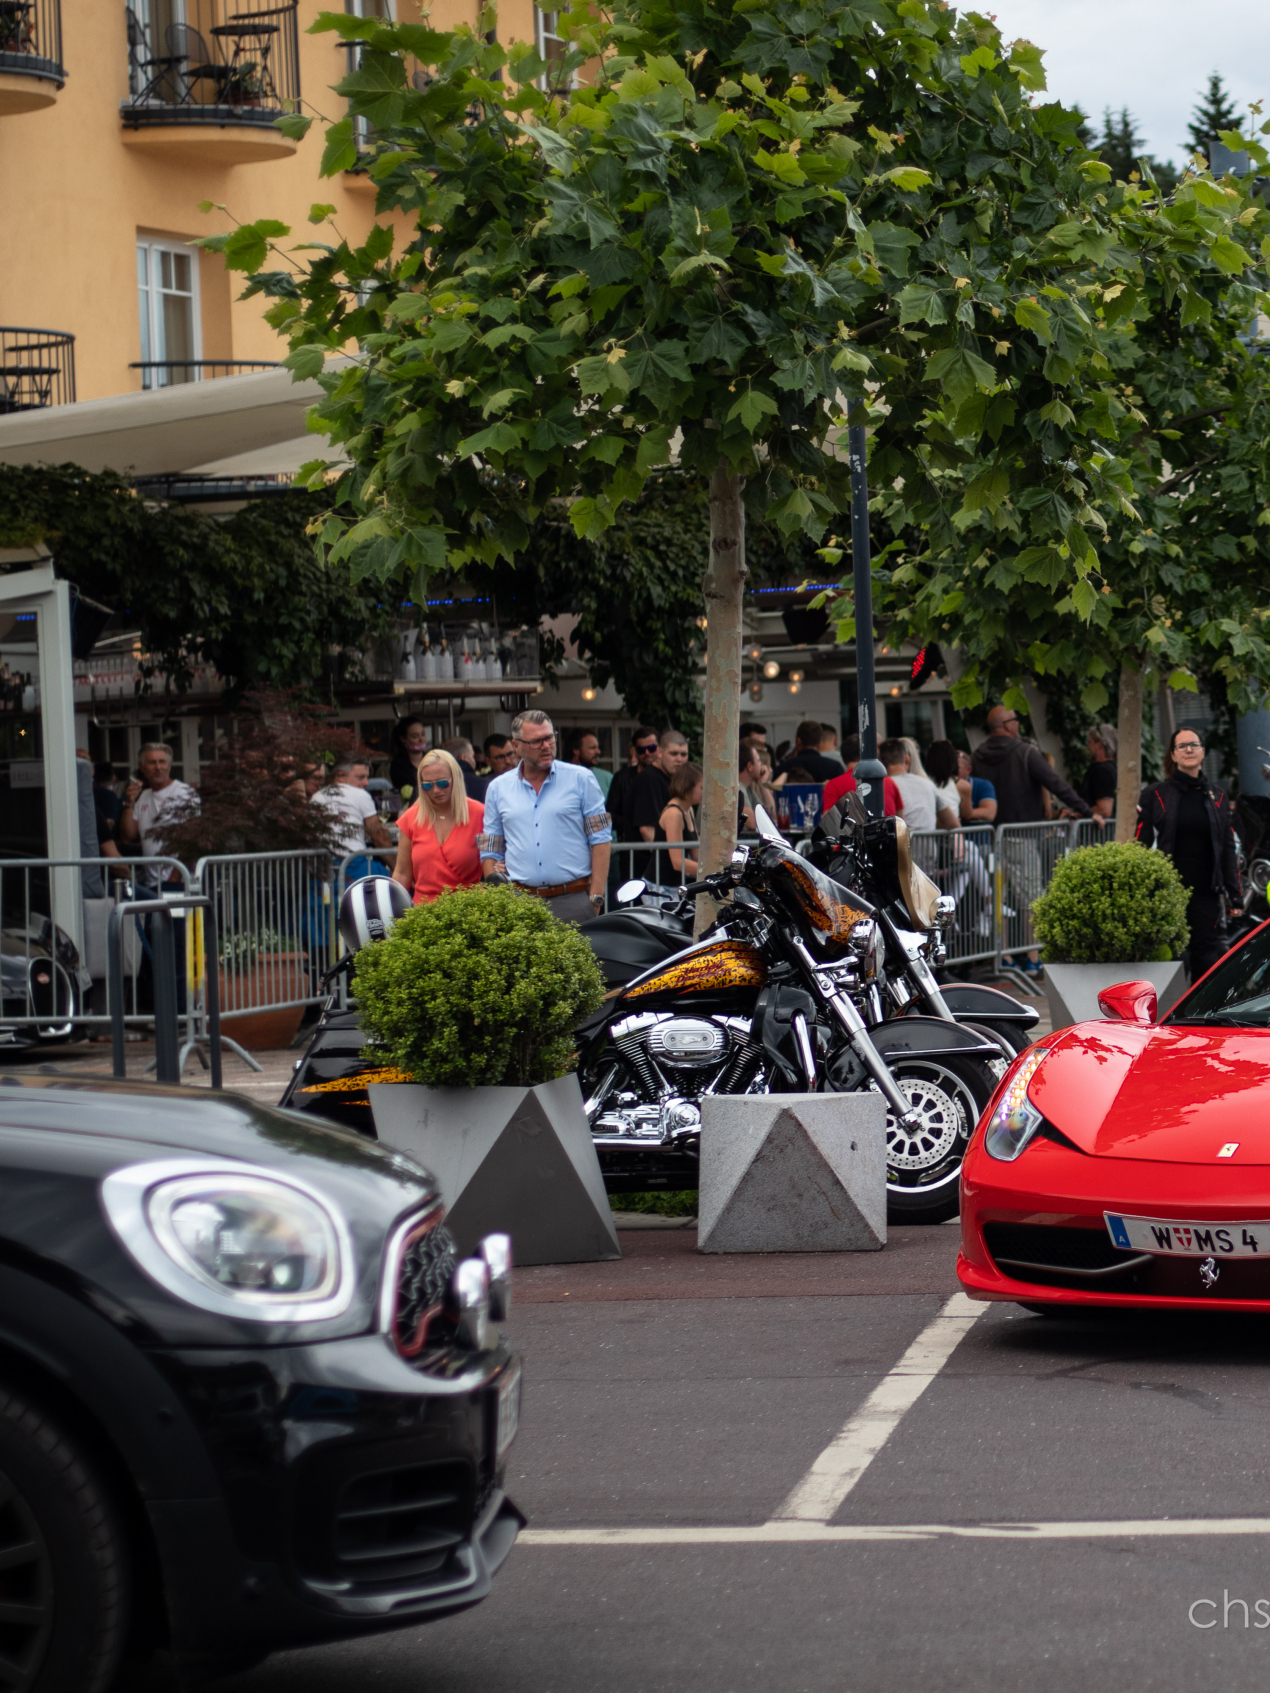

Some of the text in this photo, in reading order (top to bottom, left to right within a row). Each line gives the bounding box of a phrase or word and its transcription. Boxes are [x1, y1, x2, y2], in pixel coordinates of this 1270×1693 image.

[1118, 1225, 1259, 1253] A W MS 4
